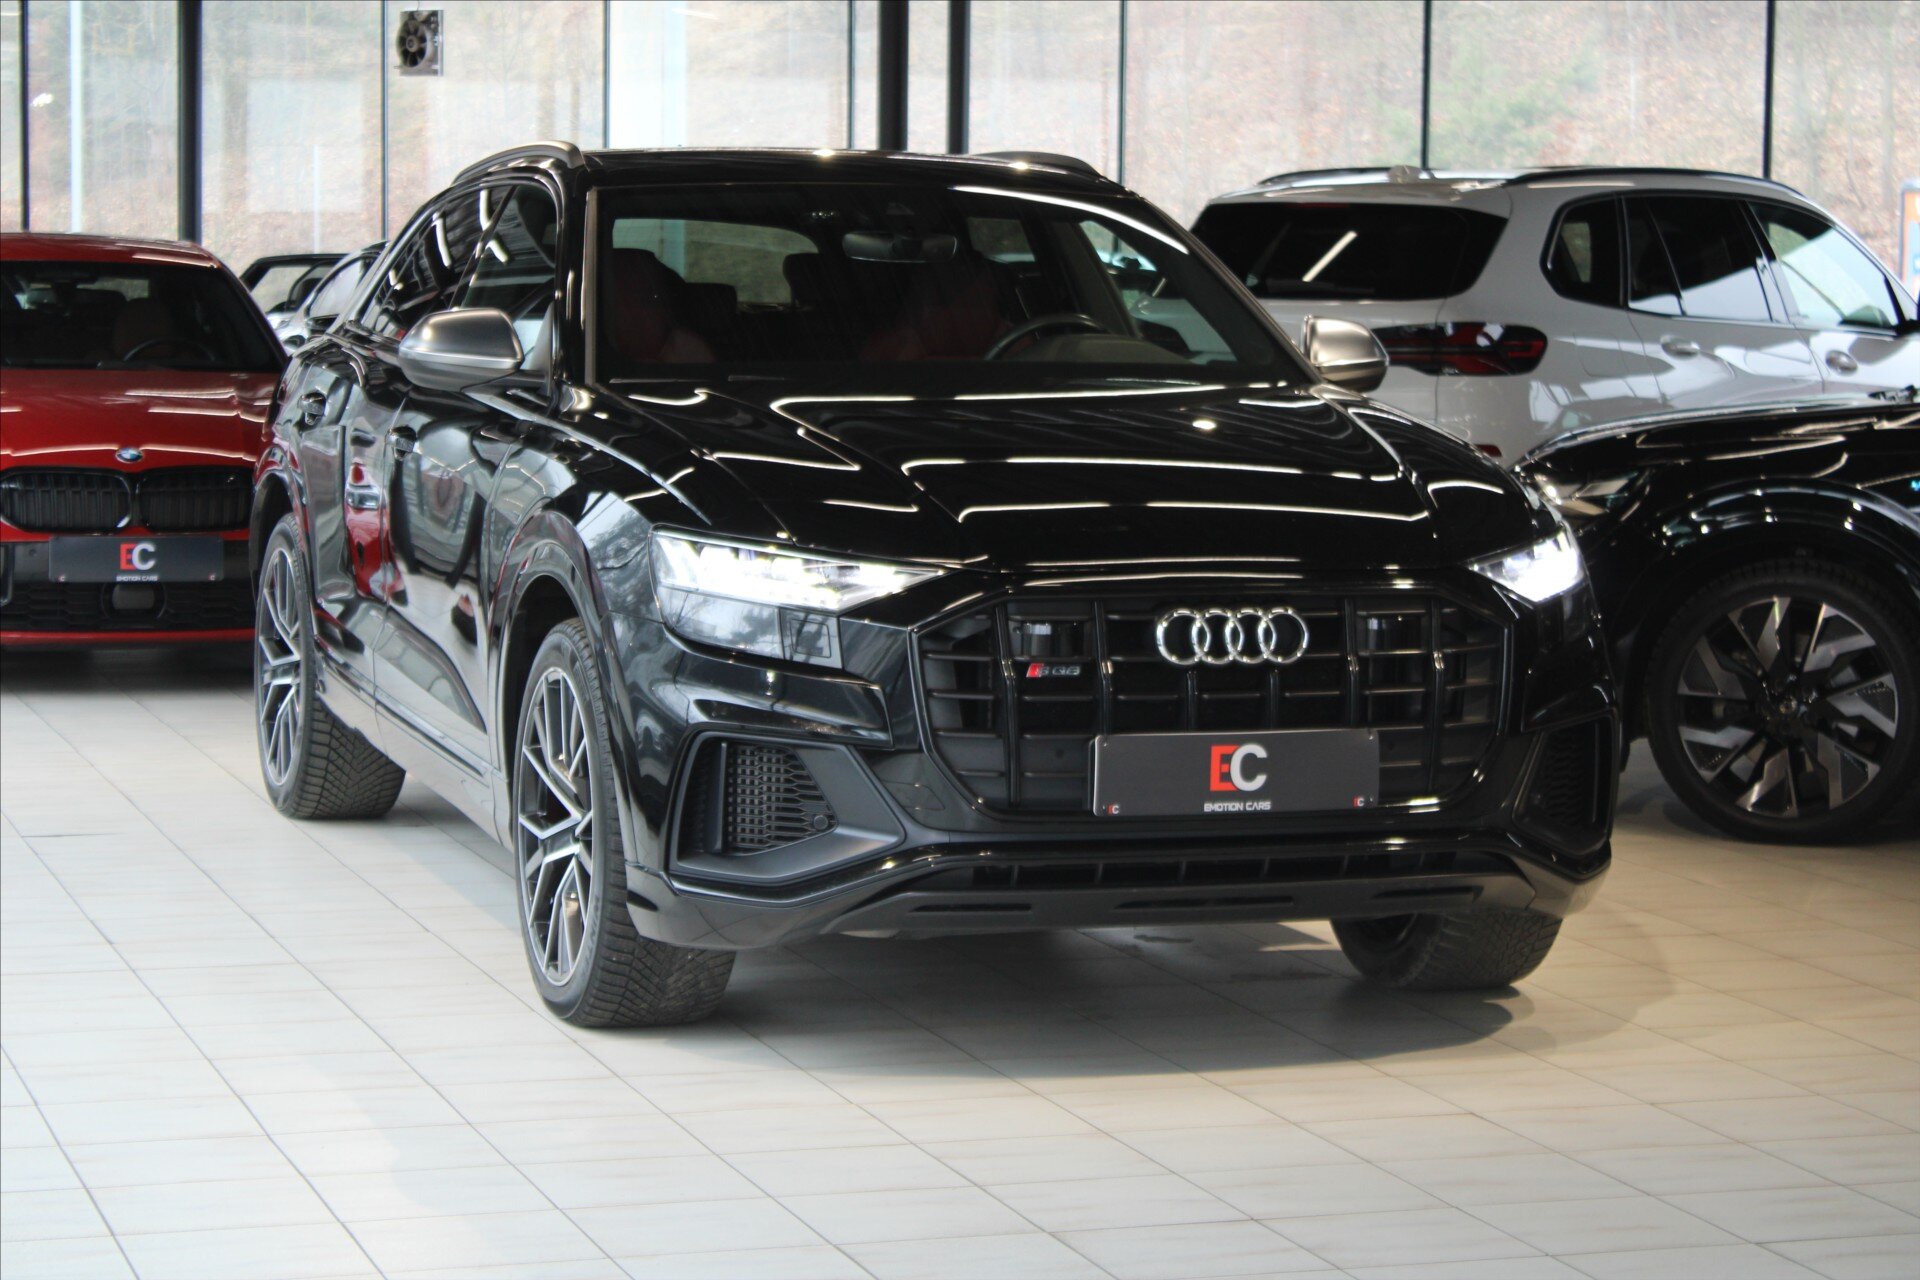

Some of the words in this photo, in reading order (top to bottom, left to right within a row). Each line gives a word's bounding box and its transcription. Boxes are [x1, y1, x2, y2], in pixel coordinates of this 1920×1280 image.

[120, 543, 156, 570] EC
[1209, 743, 1268, 792] EC
[1203, 802, 1243, 812] EMOTION
[1245, 801, 1271, 811] CARS
